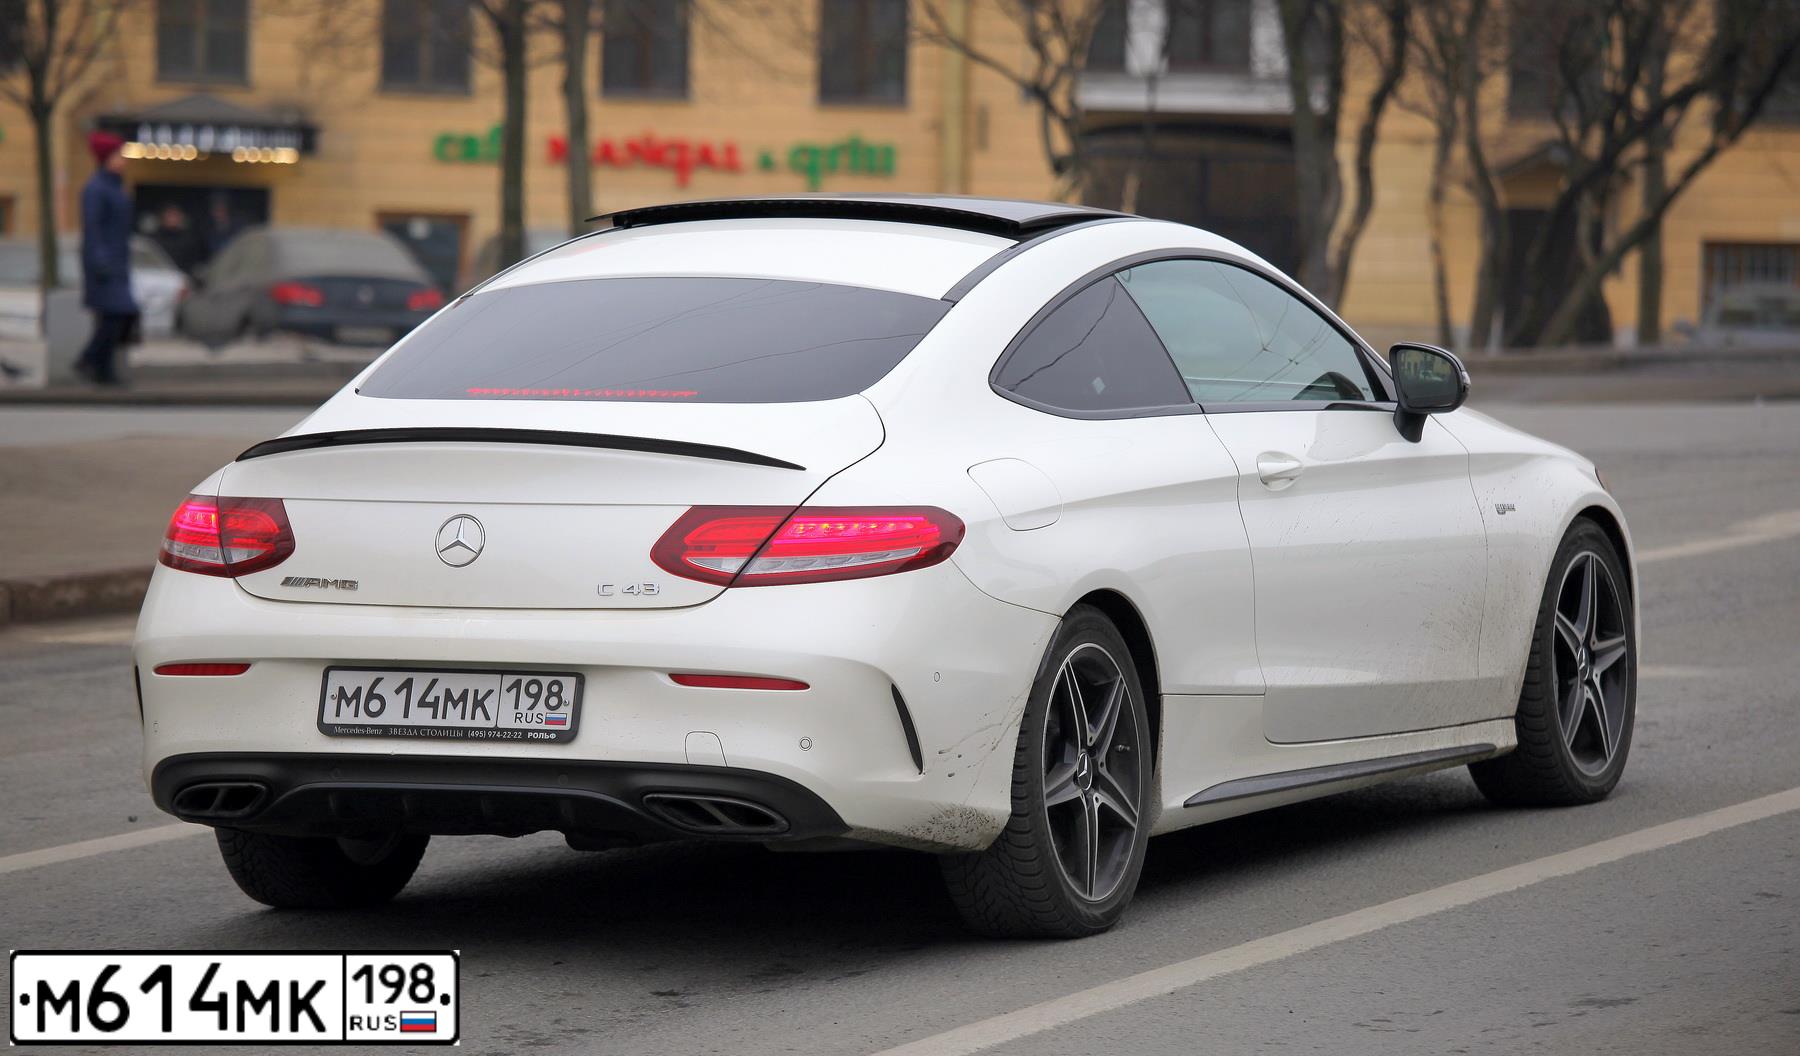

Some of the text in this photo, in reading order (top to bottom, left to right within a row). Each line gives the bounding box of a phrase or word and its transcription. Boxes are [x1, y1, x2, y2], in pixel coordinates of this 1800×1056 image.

[301, 577, 358, 591] AMG
[597, 584, 660, 597] C 43
[506, 679, 564, 711] 198
[514, 712, 544, 724] RUS
[334, 725, 383, 735] Mercedes-Benz
[467, 730, 486, 738] (495)
[487, 731, 522, 739] 974-22-22
[527, 732, 557, 740] РОЛЬФ
